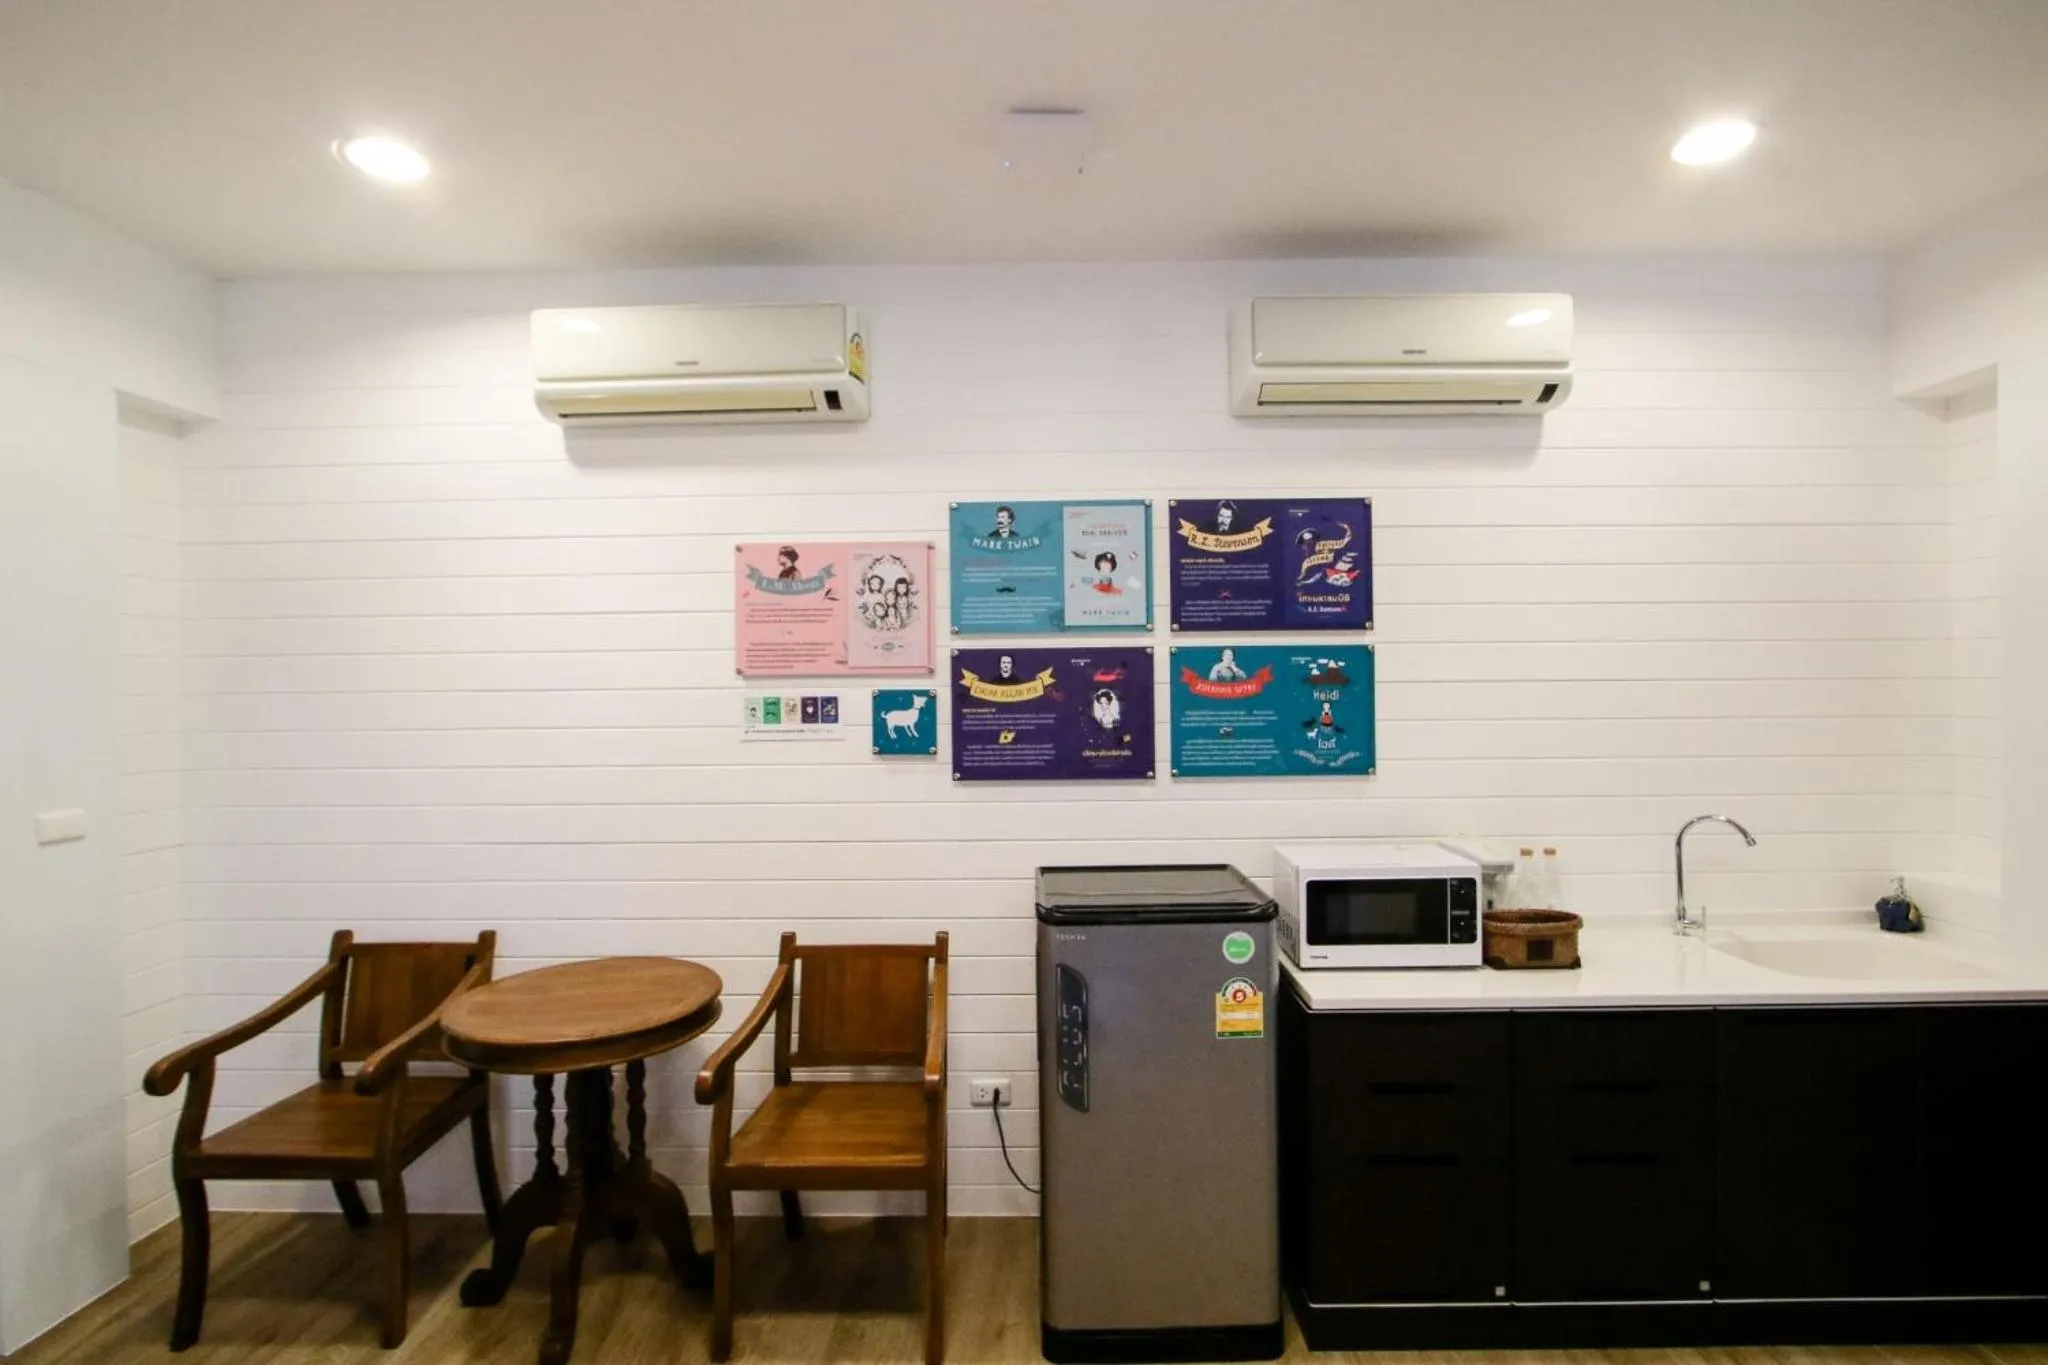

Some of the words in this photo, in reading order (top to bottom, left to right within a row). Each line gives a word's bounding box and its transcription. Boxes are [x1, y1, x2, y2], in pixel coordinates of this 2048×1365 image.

[972, 537, 1002, 550] MARK
[1007, 536, 1040, 549] TWAIN
[1313, 689, 1340, 700] Heidi
